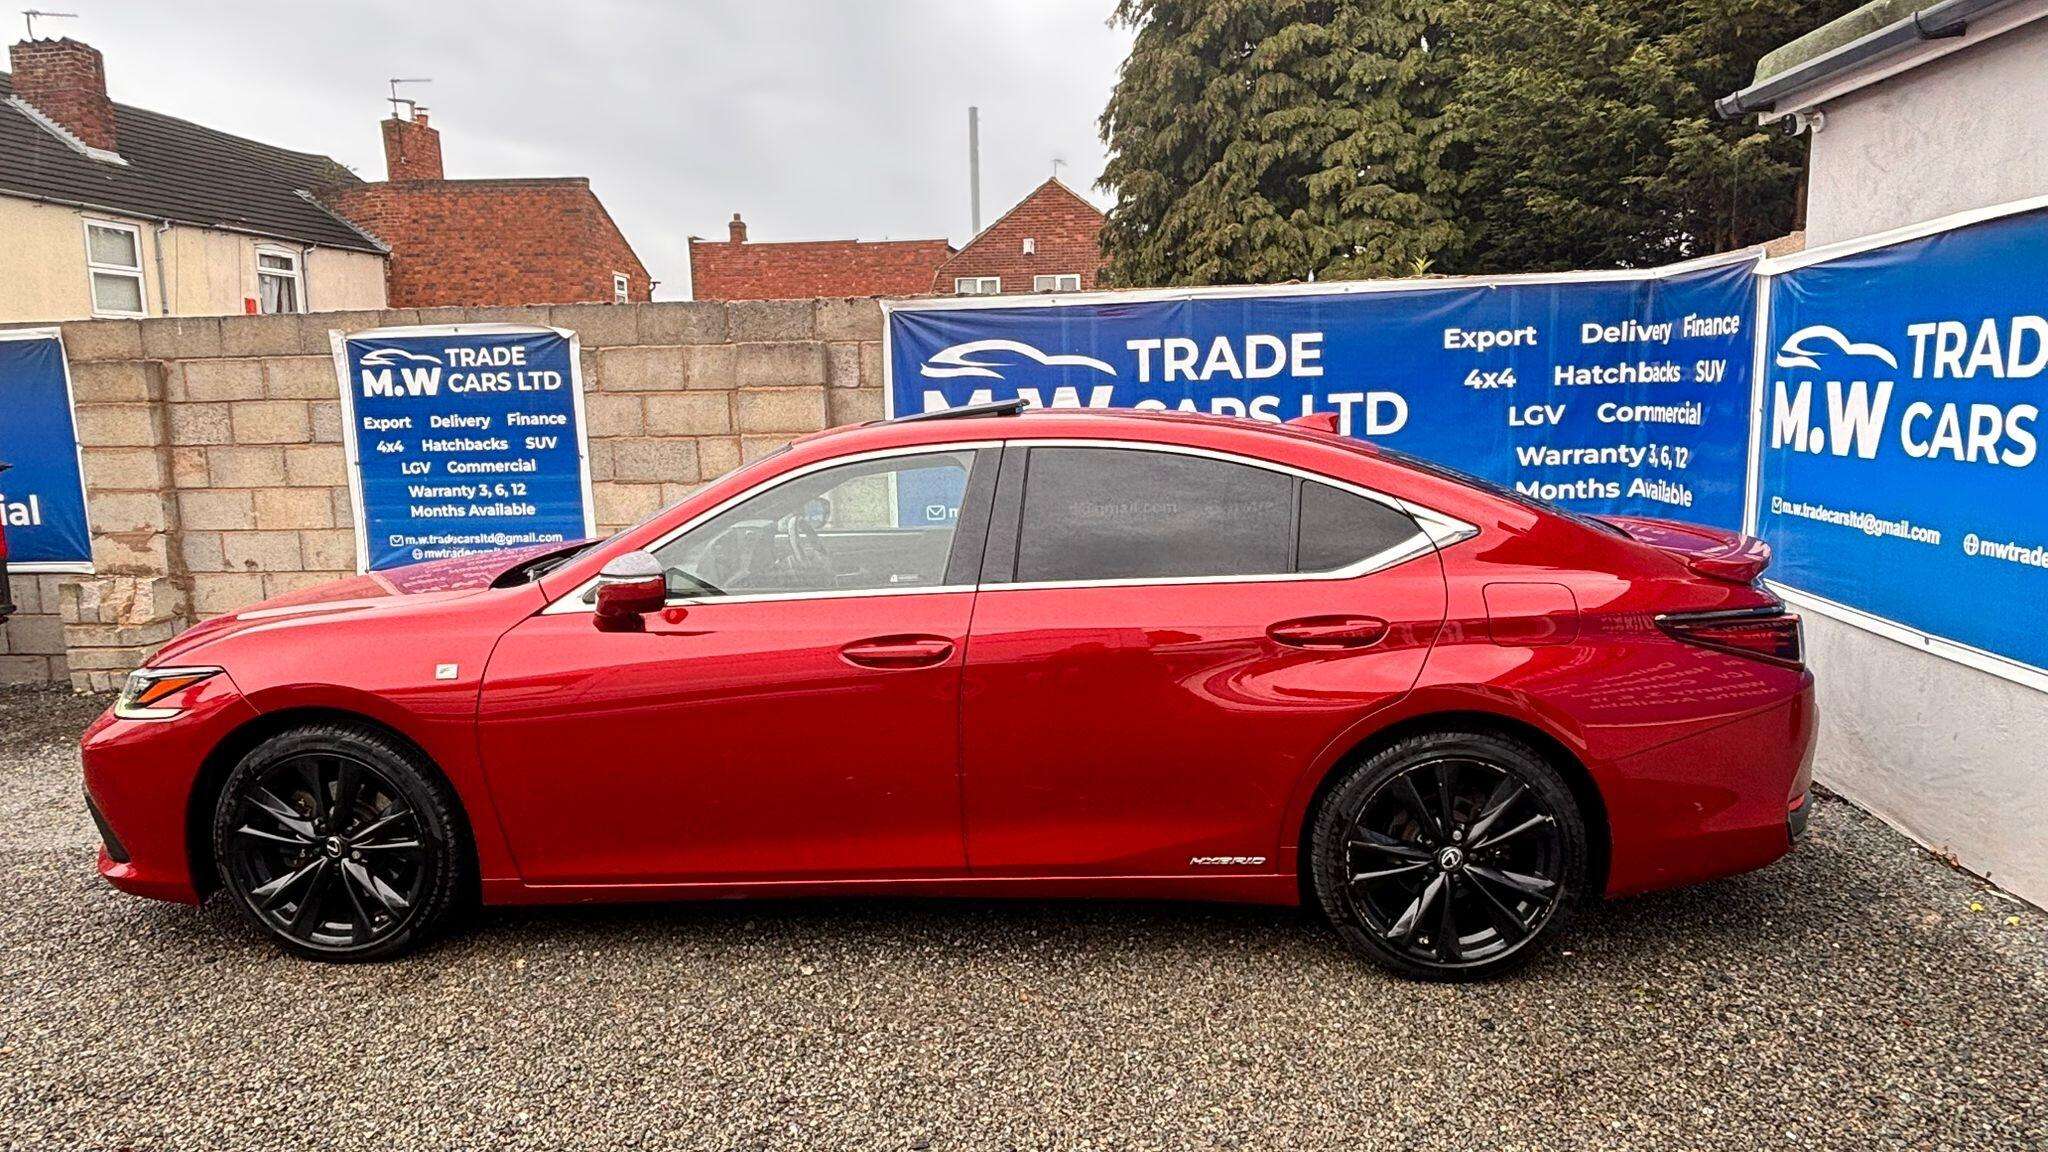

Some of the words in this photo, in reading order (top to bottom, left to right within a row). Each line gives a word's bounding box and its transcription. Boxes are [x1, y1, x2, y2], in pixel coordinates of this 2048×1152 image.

[1444, 326, 1538, 352] Export
[1581, 319, 1673, 345] Delivery
[1683, 312, 1741, 339] Finance
[444, 345, 527, 368] TRADE
[1126, 331, 1324, 383] TRADE
[361, 367, 442, 398] M.W
[447, 372, 512, 393] CARS
[517, 370, 562, 391] LTD
[1464, 367, 1517, 389] 4x4
[1554, 360, 1681, 386] Hatchbacks
[1695, 359, 1727, 383] SUV
[363, 416, 412, 432] Export
[430, 413, 491, 430] Delivery
[507, 411, 567, 427] Finance
[1509, 404, 1566, 426] LGV
[1597, 400, 1702, 425] Commercial
[1771, 381, 1894, 460] M.W
[376, 440, 405, 453] 4x4
[421, 436, 509, 452] Hatchbacks
[525, 436, 558, 450] SUV
[1900, 401, 2039, 468] CARS
[401, 461, 431, 475] LGV
[446, 458, 537, 474] Commercial
[1516, 444, 1647, 468] Warranty
[1649, 443, 1659, 468] 3,
[1660, 445, 1673, 470] 6,
[1674, 446, 1689, 469] 12
[408, 484, 476, 500] Warranty
[478, 484, 492, 499] 3,
[494, 483, 509, 498] 6,
[510, 482, 527, 496] 12
[1515, 477, 1621, 500] Months
[1626, 477, 1693, 507] Available
[410, 504, 466, 518] Months
[468, 502, 536, 517] Available
[1782, 501, 1942, 546] m.w.tradecarsltd@gmail.com
